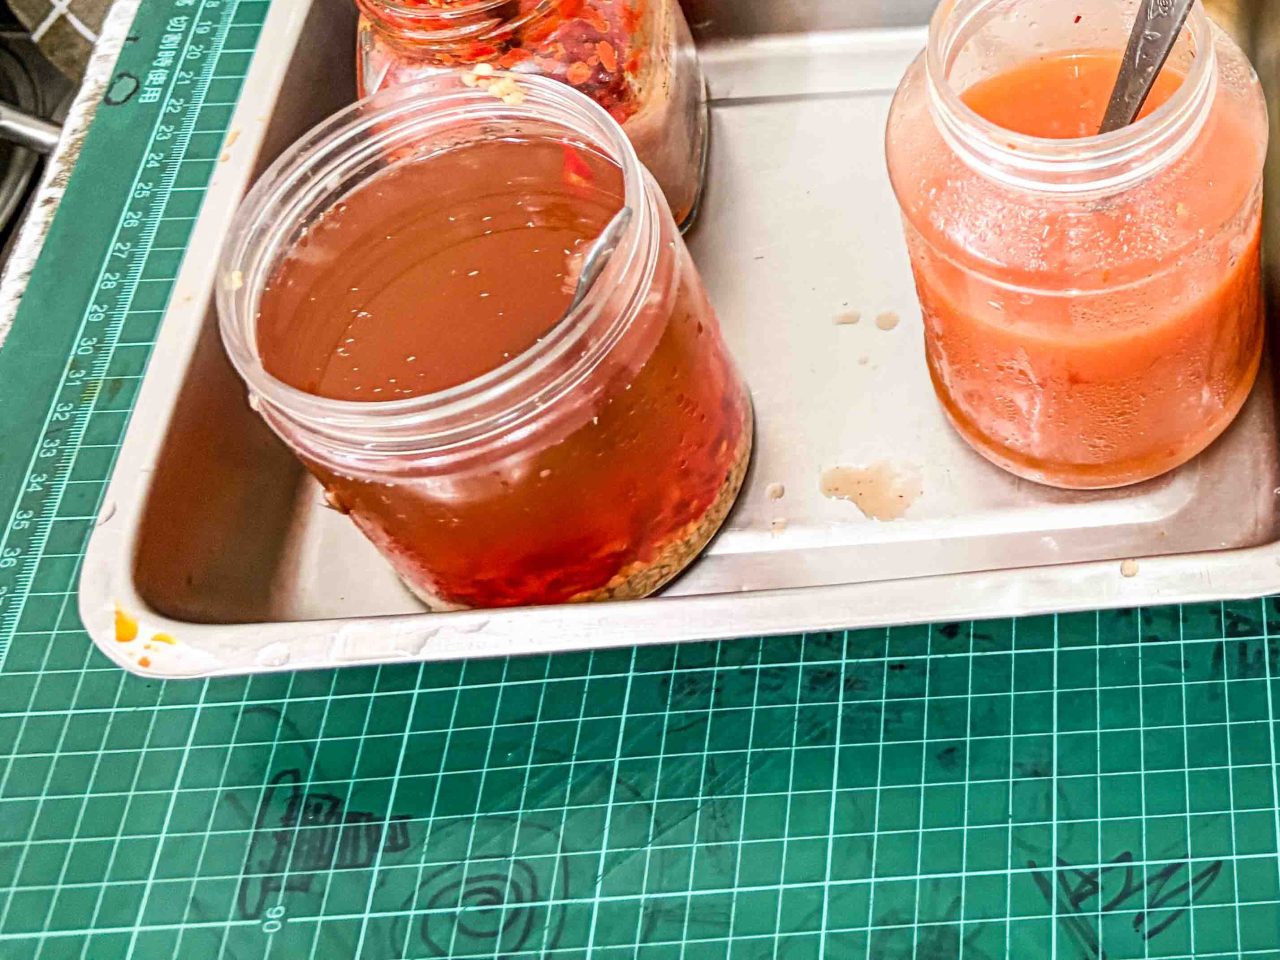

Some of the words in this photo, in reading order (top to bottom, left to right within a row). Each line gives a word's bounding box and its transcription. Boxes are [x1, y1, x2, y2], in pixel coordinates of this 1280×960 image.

[196, 21, 211, 34] 19
[186, 45, 204, 60] 20
[176, 71, 194, 85] 21
[166, 98, 184, 114] 22
[156, 125, 174, 141] 23
[146, 152, 164, 168] 24
[134, 182, 153, 198] 25
[124, 211, 142, 228] 26
[112, 243, 131, 259] 27
[101, 272, 120, 290] 28
[88, 303, 108, 322] 29
[77, 337, 97, 356] 30
[65, 370, 86, 386] 31
[52, 403, 74, 421] 32
[39, 439, 61, 458] 33
[26, 474, 47, 493] 34
[12, 510, 34, 530] 35
[0, 547, 22, 568] 36
